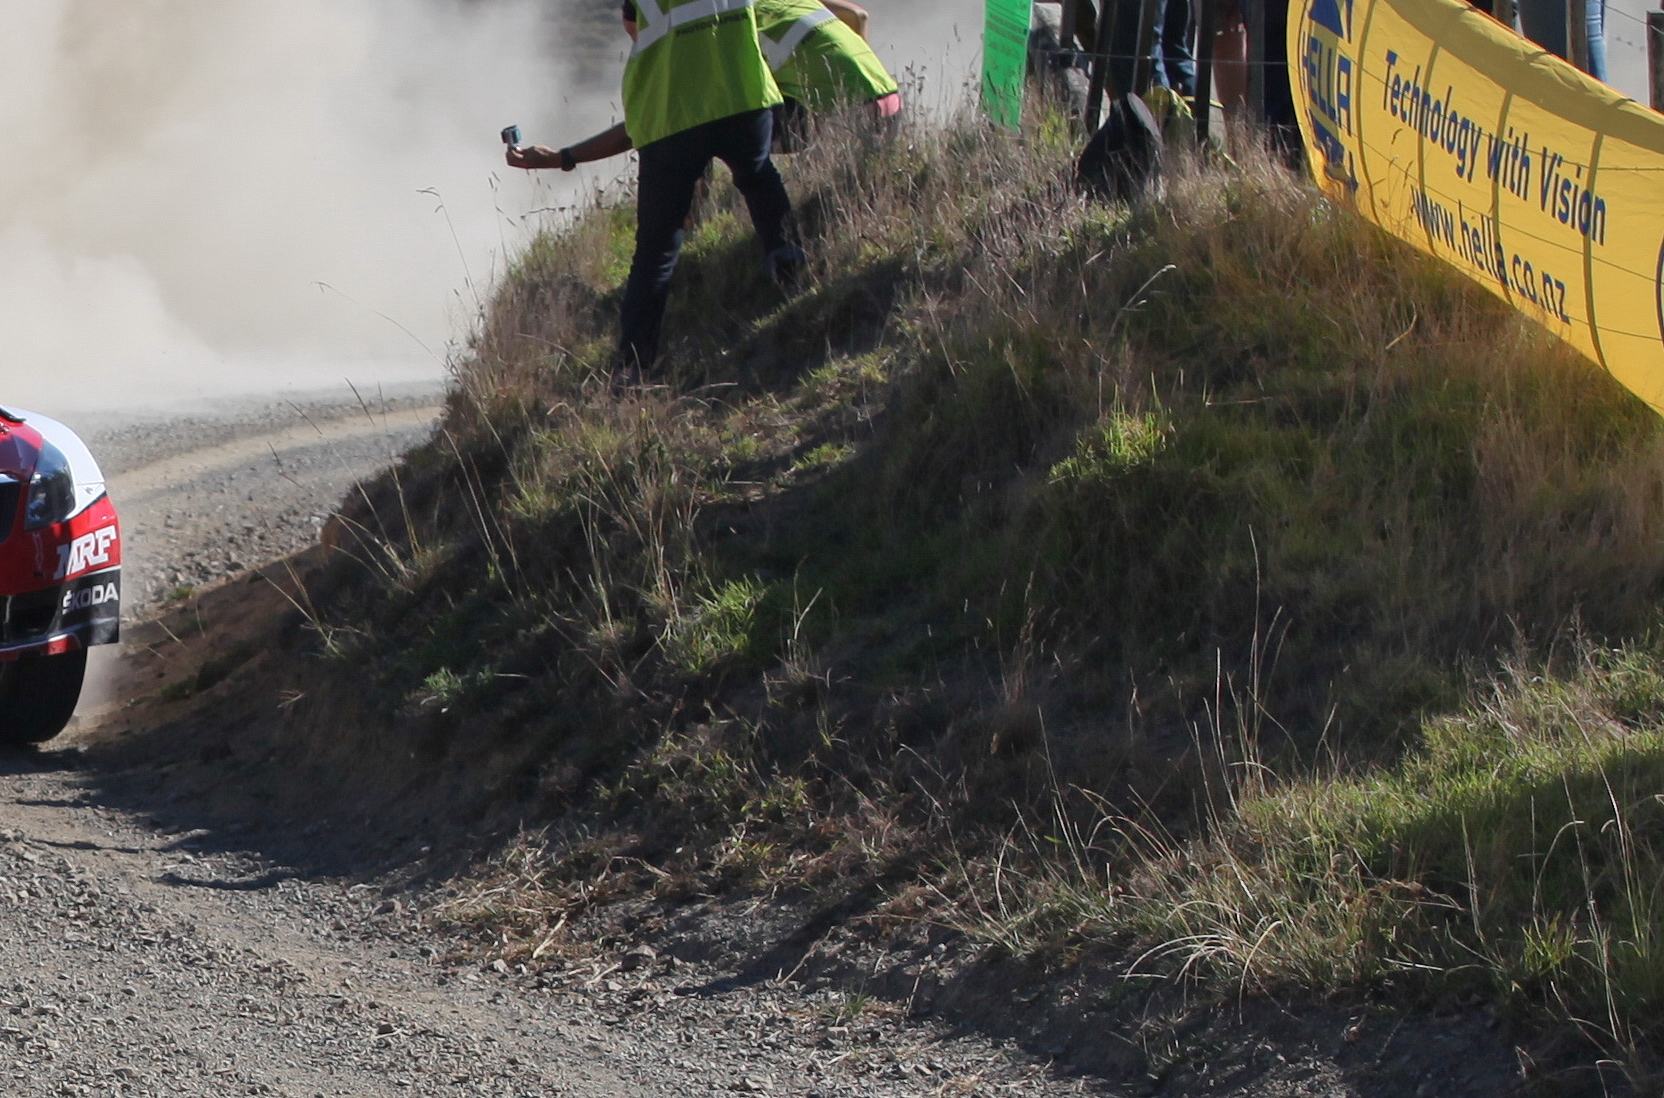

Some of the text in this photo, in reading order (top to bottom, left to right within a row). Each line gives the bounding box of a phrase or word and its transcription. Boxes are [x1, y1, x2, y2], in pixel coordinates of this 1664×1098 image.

[1383, 49, 1608, 246] Technology with Vision
[1410, 184, 1572, 325] www.hella.co.nz
[53, 525, 117, 579] MRF
[61, 583, 119, 615] ŠKODA
